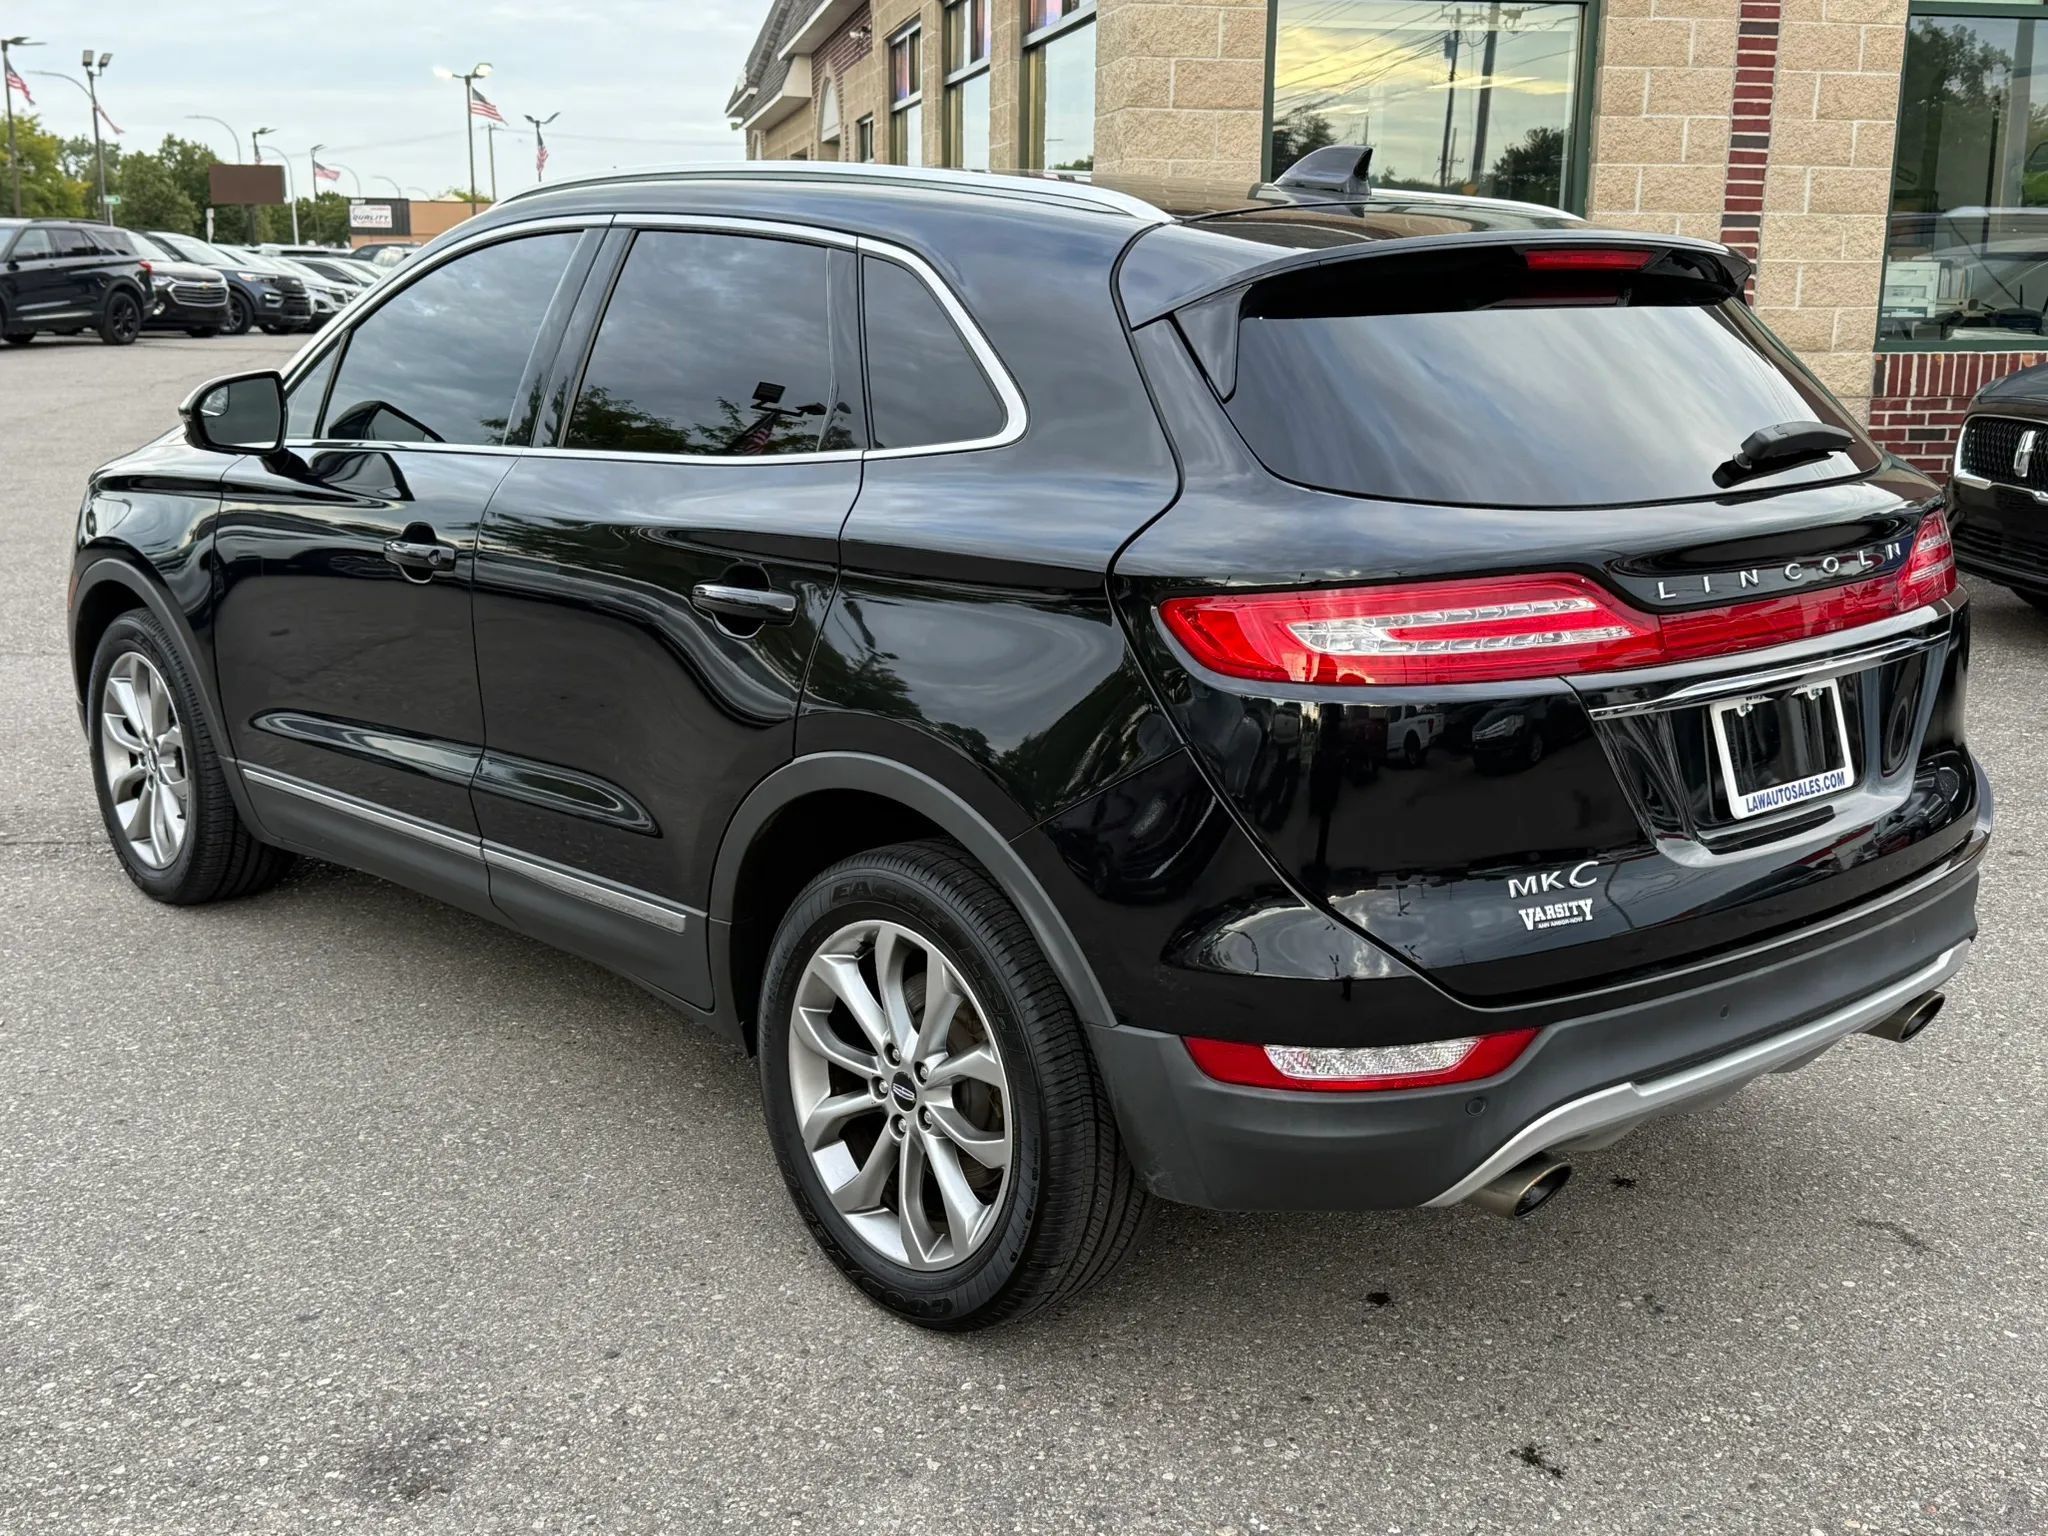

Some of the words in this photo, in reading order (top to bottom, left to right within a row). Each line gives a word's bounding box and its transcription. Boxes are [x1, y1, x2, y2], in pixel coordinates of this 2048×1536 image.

[1657, 542, 1902, 600] LINCOLN
[1745, 771, 1846, 813] LAWAUTOSALES.COM
[1508, 861, 1600, 899] MKC
[1518, 897, 1594, 931] VARSITY
